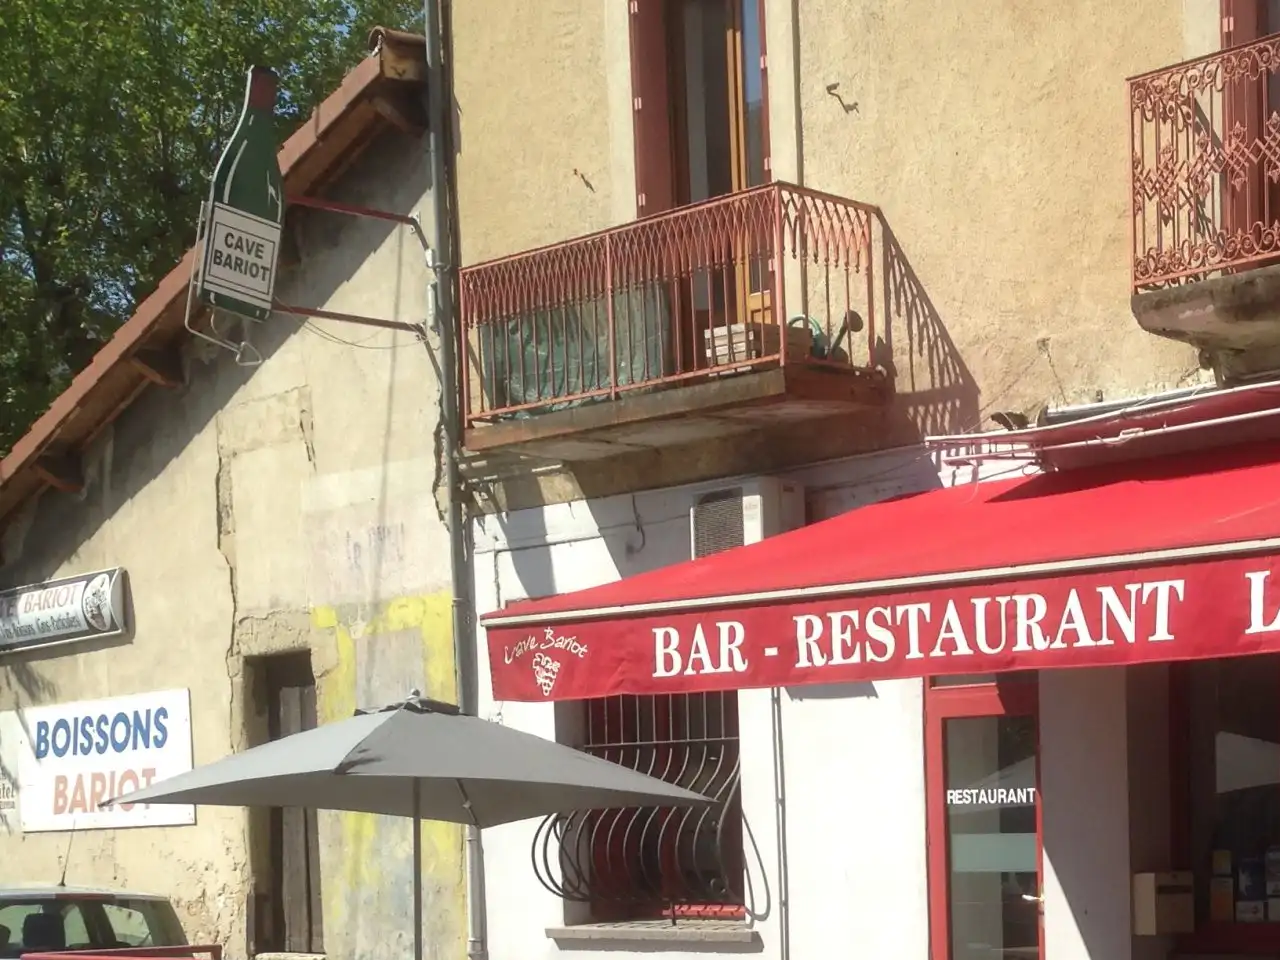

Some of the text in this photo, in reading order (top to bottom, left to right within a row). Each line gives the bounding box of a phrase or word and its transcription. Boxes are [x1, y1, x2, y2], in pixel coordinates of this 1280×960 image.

[224, 232, 265, 260] CAVE
[213, 249, 270, 281] BARIOT
[23, 585, 79, 613] BARIOT
[504, 626, 588, 664] Cave Bariot
[652, 620, 748, 678] BAR
[792, 579, 1185, 668] RESTAURANT
[36, 707, 169, 759] BOISSONS
[53, 767, 156, 815] BARIOT
[946, 787, 1036, 805] RESTAURANT
